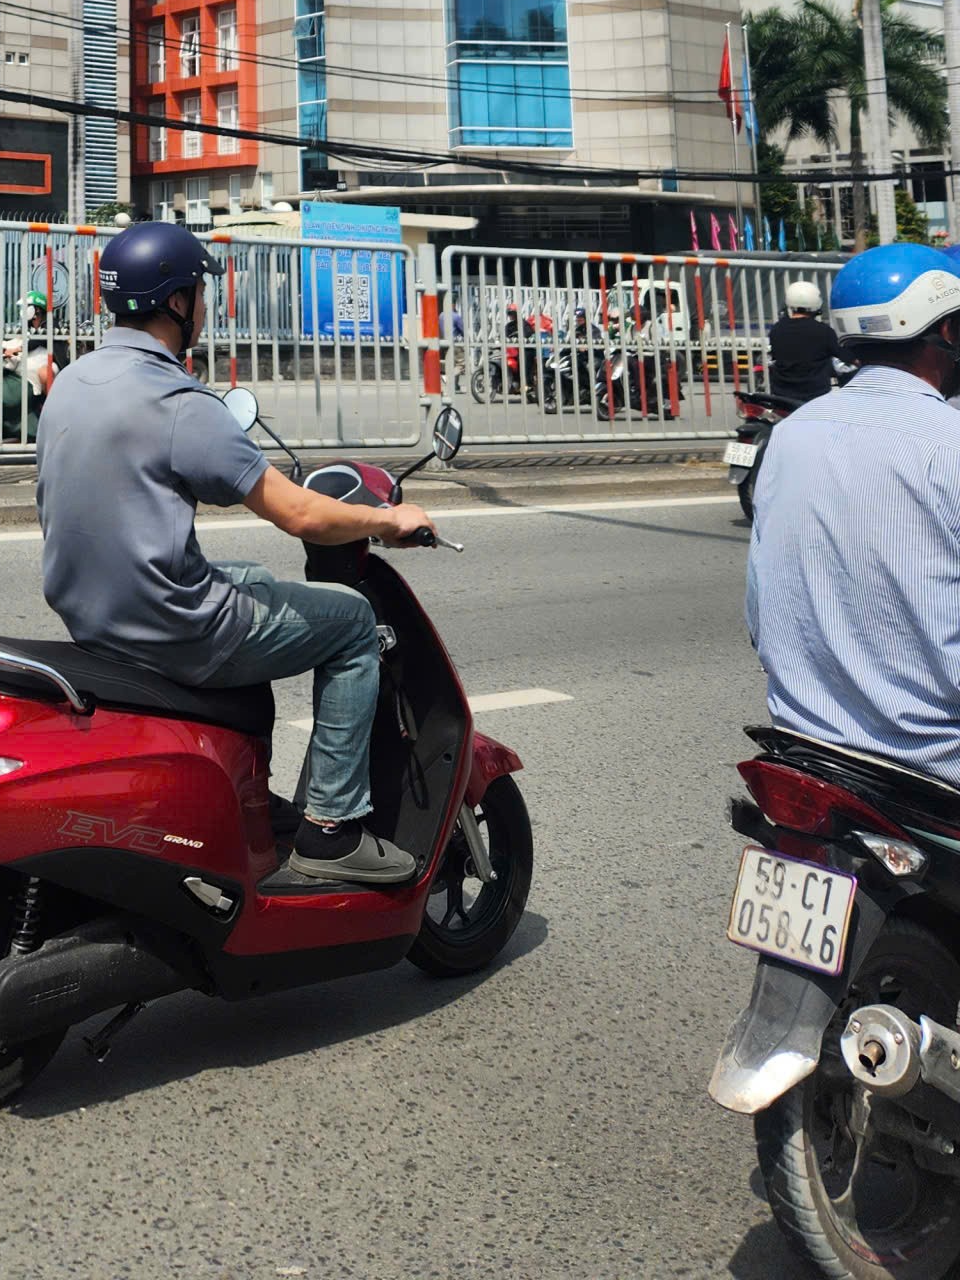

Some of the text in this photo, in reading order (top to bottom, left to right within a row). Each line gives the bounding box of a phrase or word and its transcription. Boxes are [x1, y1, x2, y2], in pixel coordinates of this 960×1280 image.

[927, 286, 960, 305] SAIGON
[57, 810, 168, 854] EVO
[163, 833, 205, 849] GRAND
[754, 856, 833, 916] 59-C1
